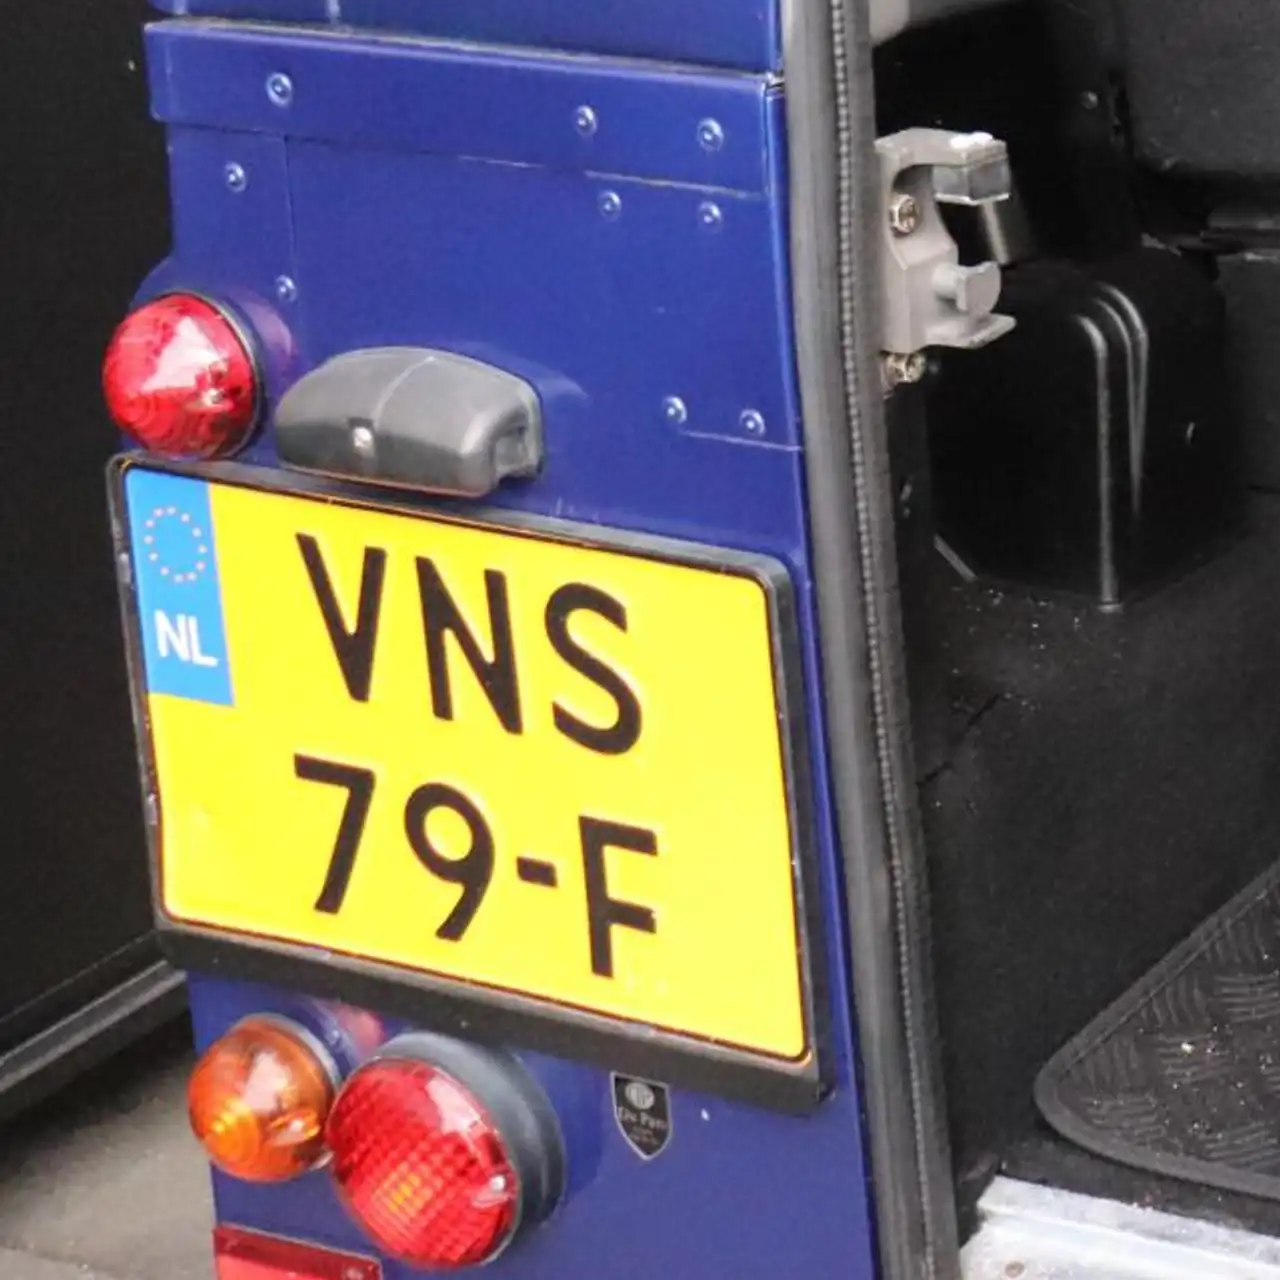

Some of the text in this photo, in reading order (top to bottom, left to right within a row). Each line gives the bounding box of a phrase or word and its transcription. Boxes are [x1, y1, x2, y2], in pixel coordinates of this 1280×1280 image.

[154, 609, 219, 667] NL
[295, 531, 643, 756] VNS
[293, 752, 659, 978] 79-F
